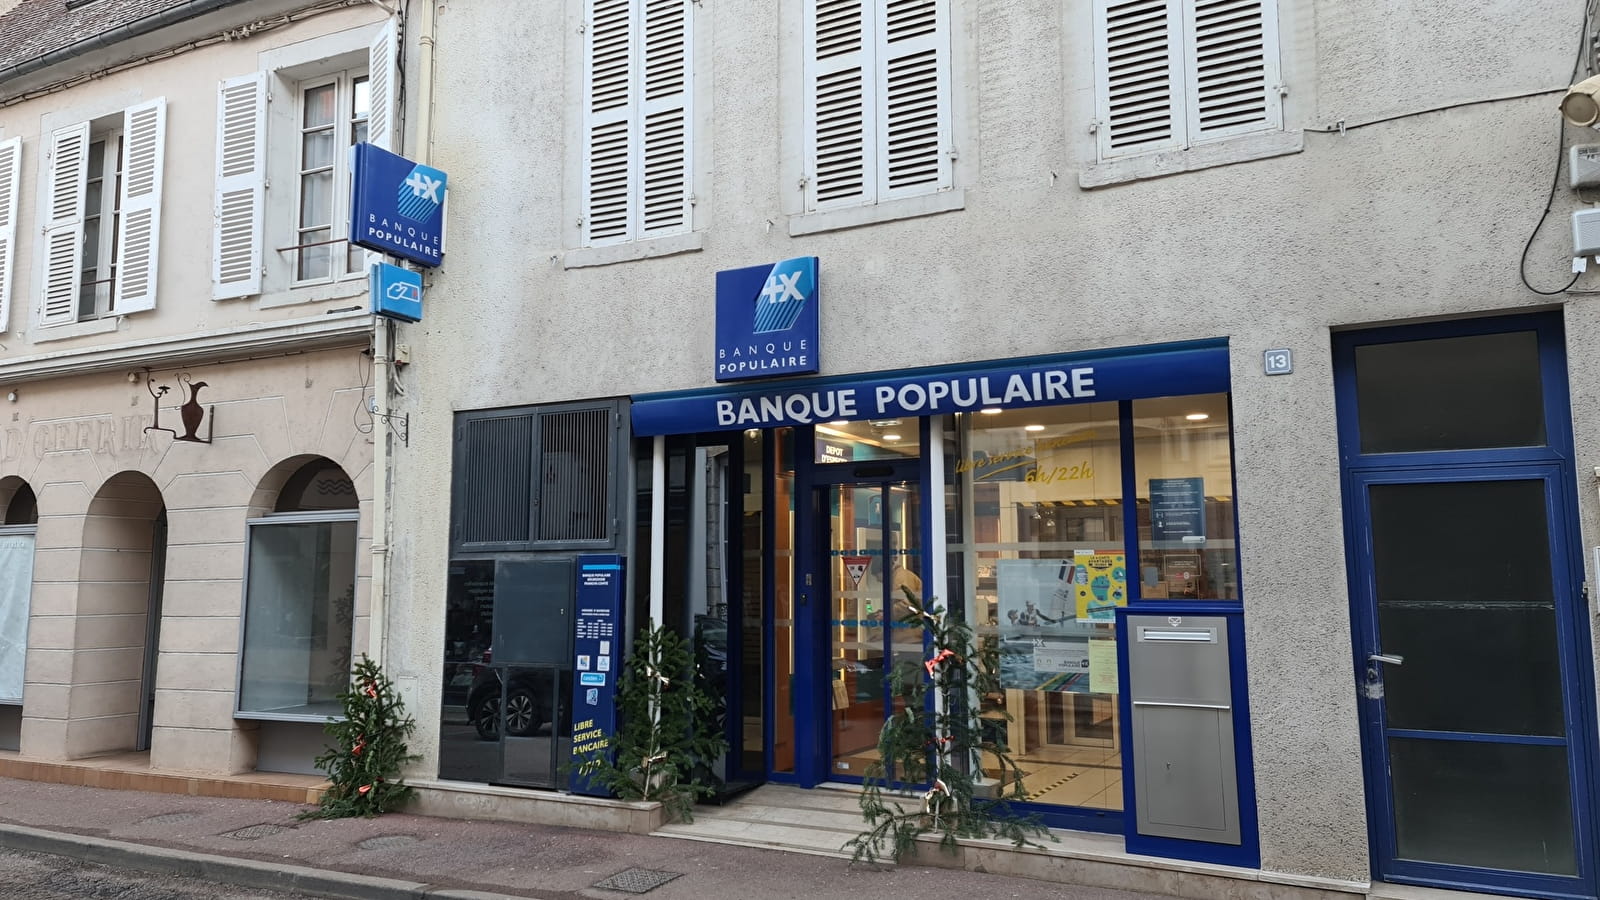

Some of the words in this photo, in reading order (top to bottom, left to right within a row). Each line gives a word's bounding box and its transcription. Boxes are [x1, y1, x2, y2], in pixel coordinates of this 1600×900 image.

[369, 213, 439, 245] BANQUE
[368, 227, 439, 258] POPULAIRE
[719, 339, 807, 359] BANQUE
[719, 355, 807, 374] POPULAIRE
[1269, 354, 1287, 369] 13
[716, 389, 858, 427] BANQUE
[875, 366, 1097, 414] POPULAIRE
[1025, 460, 1094, 485] 6h/22h
[573, 719, 593, 732] LIBRE
[573, 728, 602, 743] SERVICE
[572, 739, 609, 755] BANCAIRE
